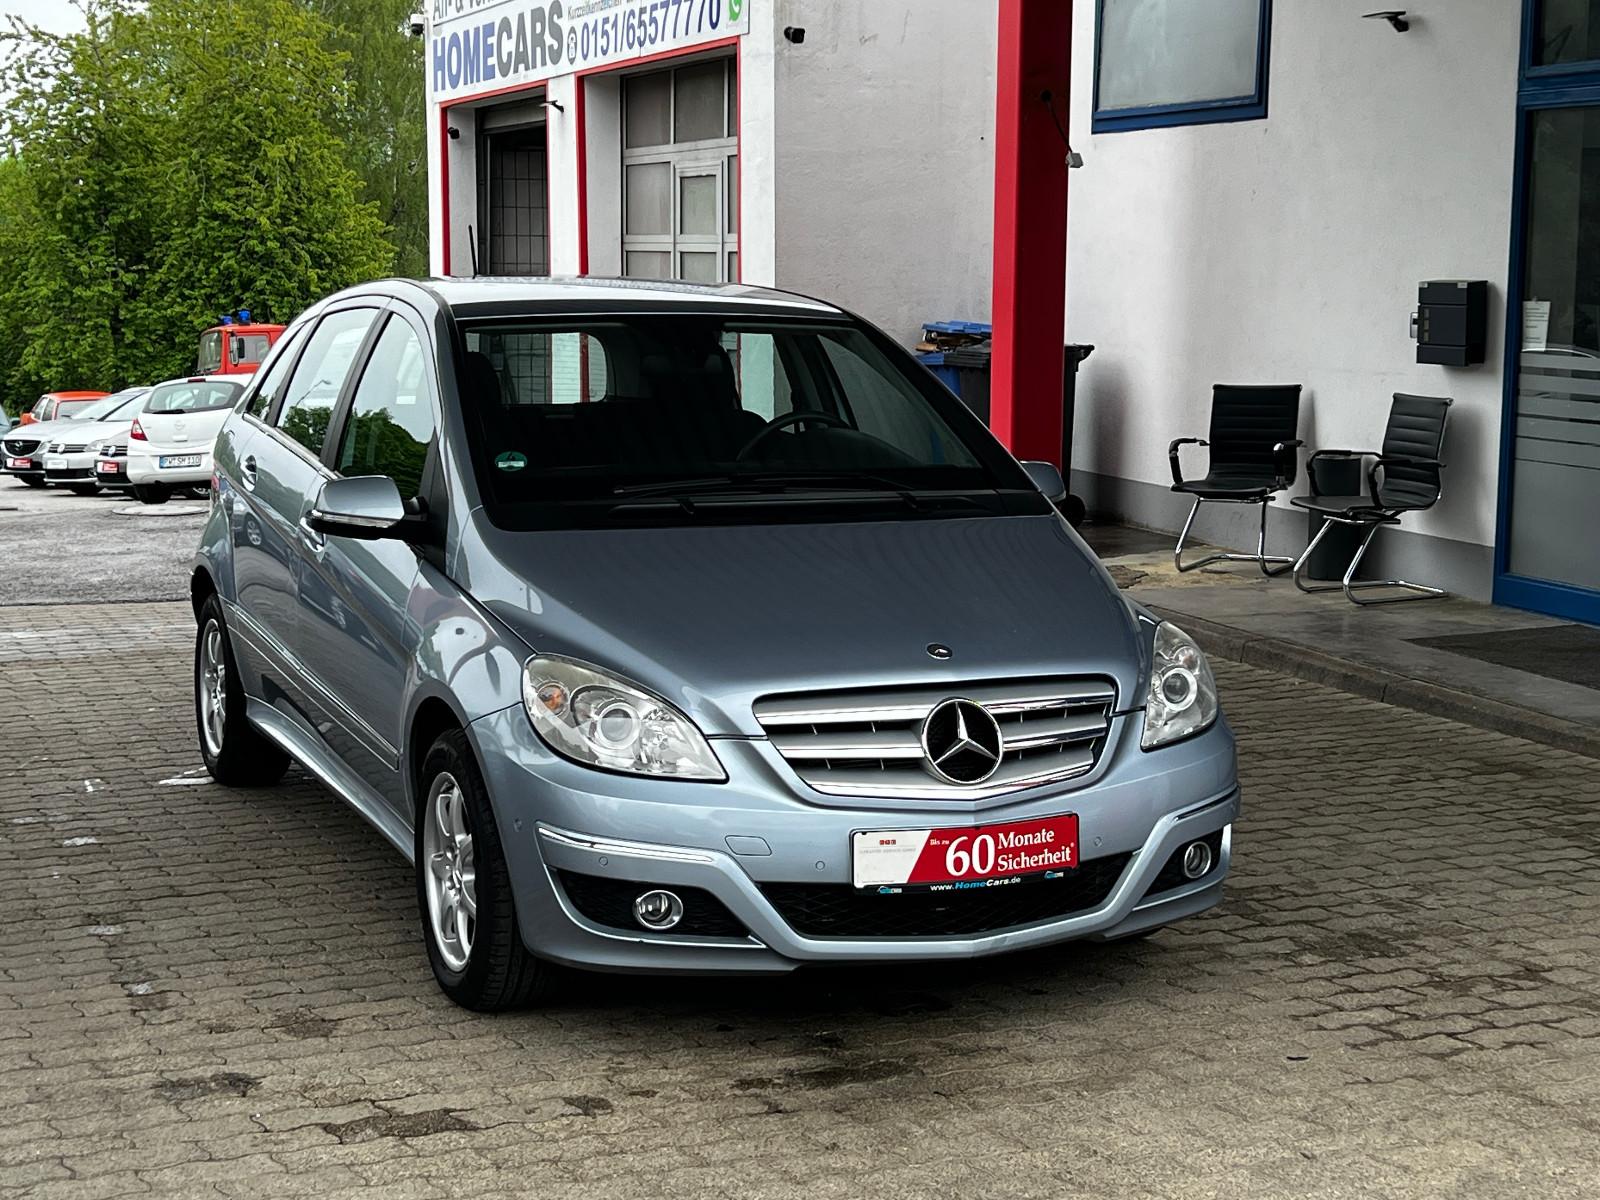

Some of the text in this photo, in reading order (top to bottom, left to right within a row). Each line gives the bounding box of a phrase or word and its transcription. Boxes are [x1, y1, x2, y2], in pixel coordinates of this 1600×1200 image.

[433, 0, 564, 92] HOMECARS
[581, 0, 721, 61] 0151/65577770
[945, 834, 996, 877] 60
[997, 828, 1055, 850] Monate
[930, 877, 1021, 892] www.HomeCars.de
